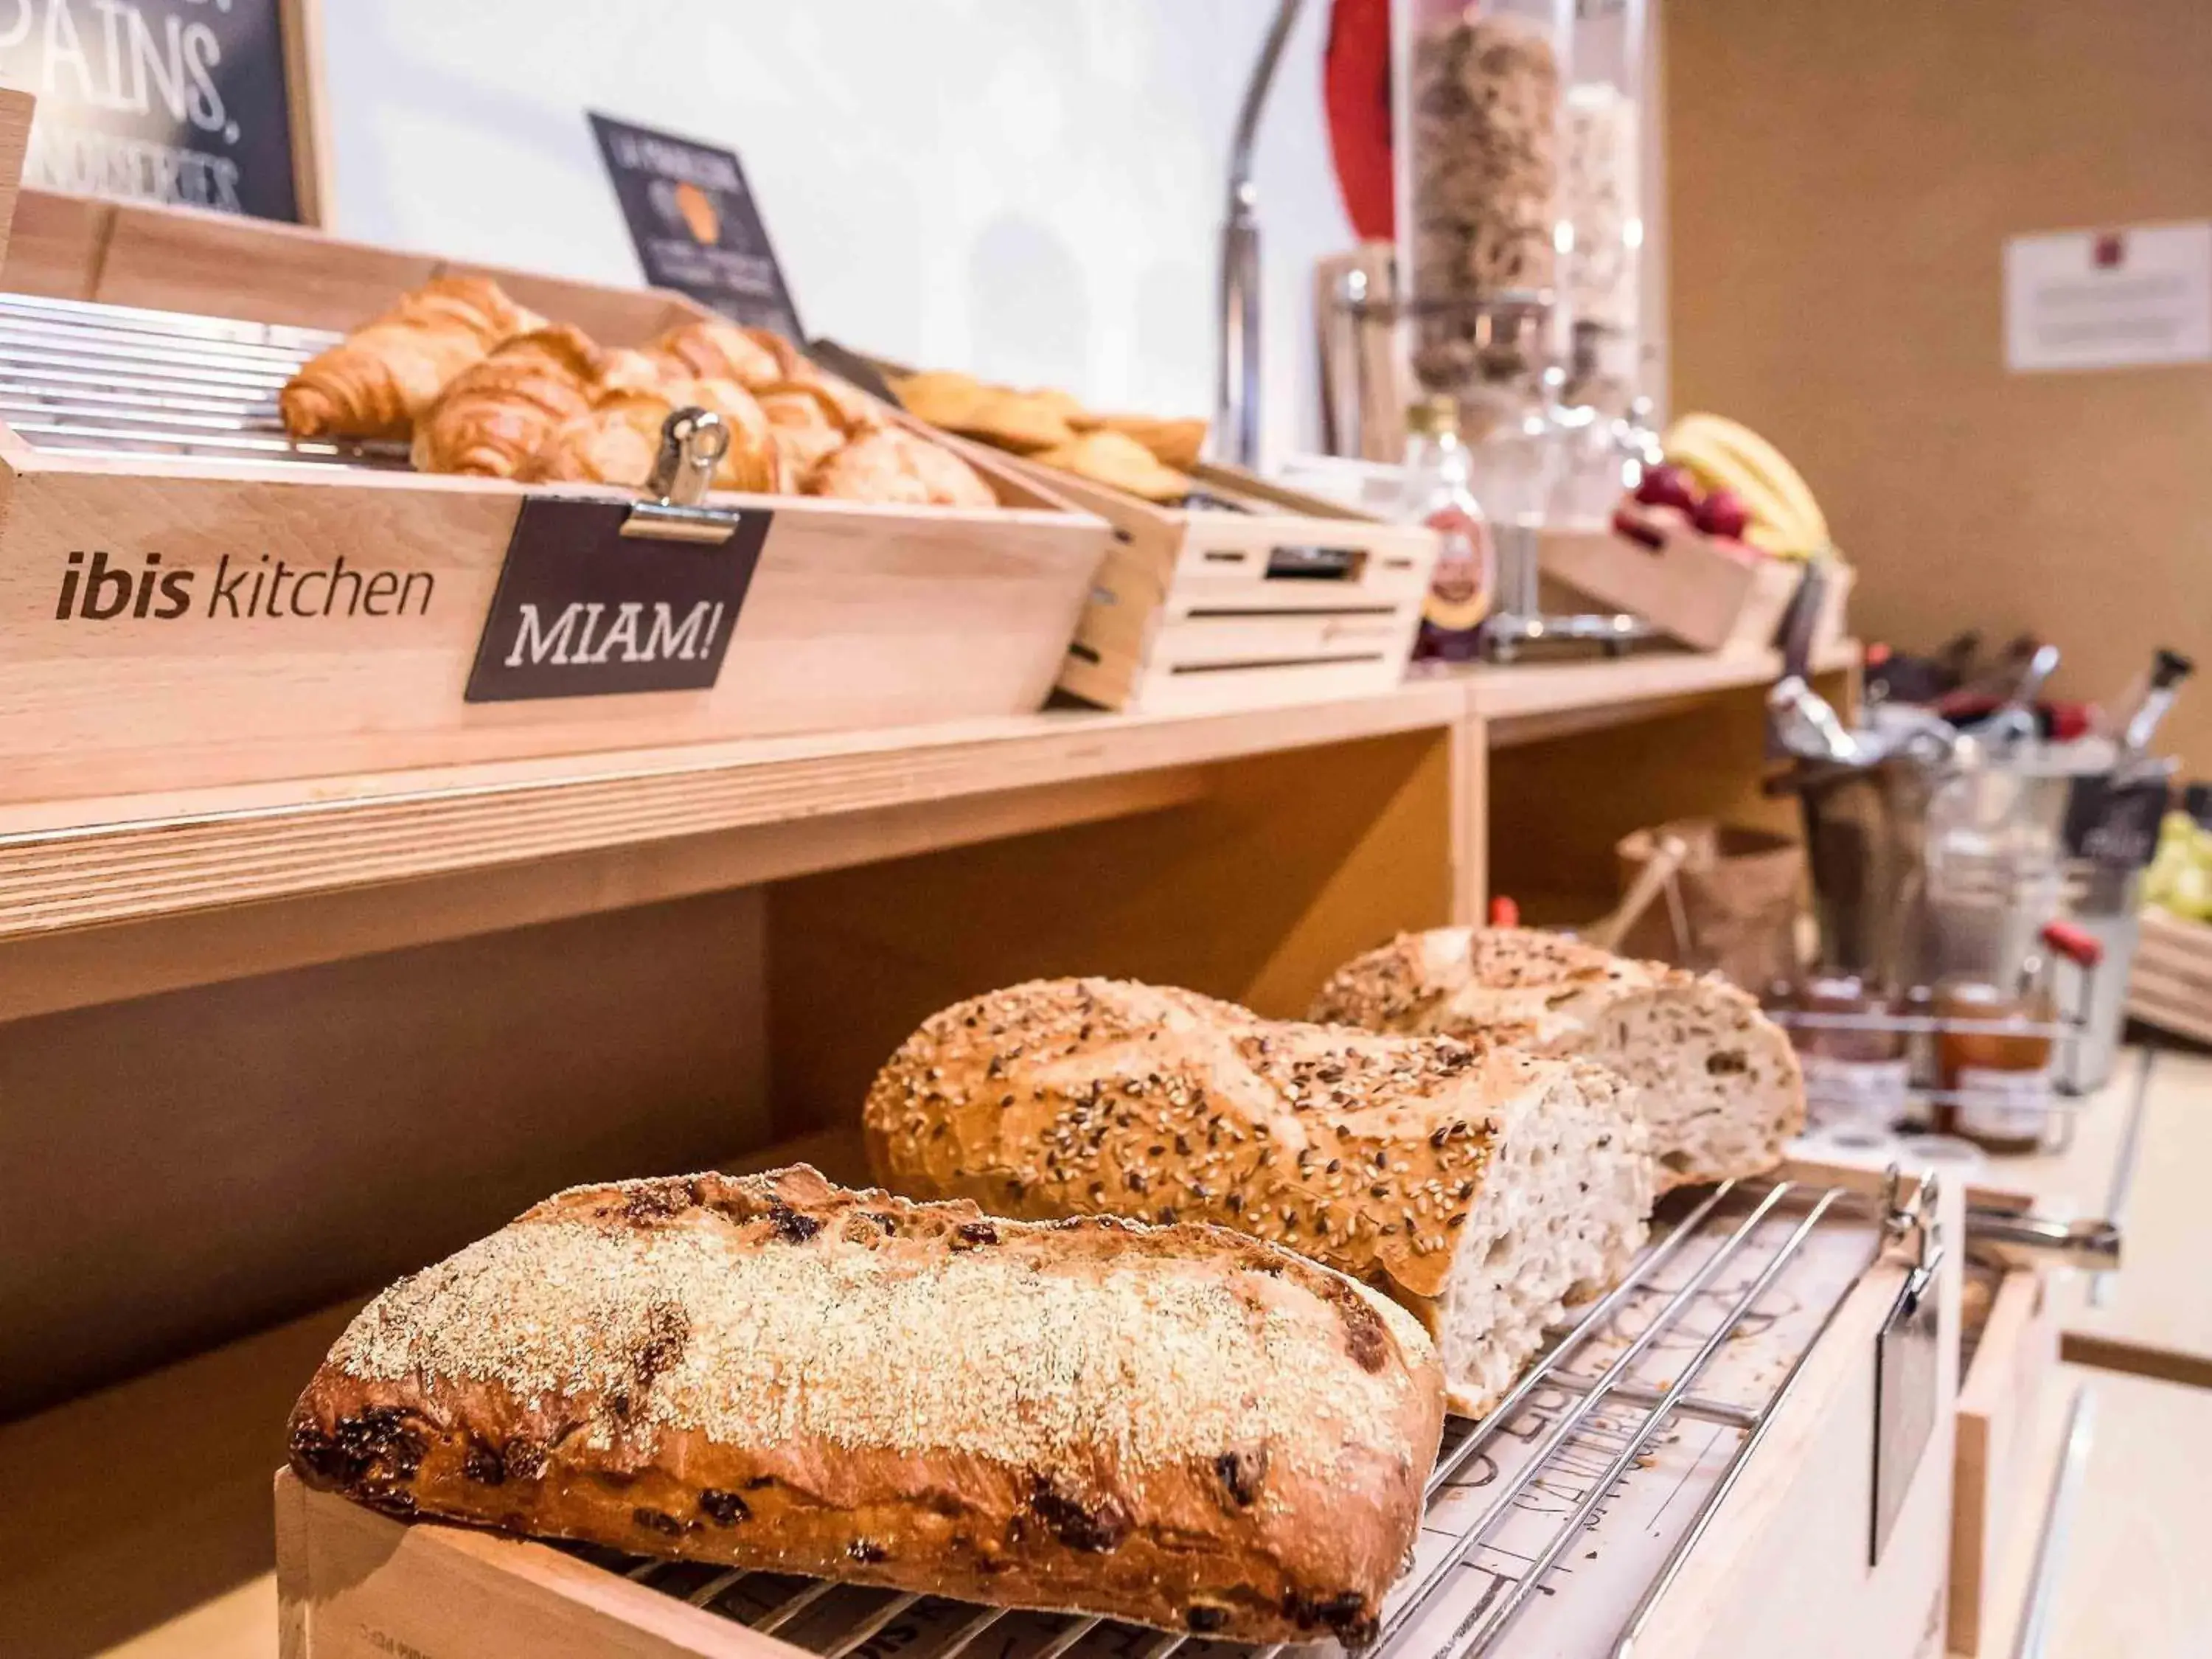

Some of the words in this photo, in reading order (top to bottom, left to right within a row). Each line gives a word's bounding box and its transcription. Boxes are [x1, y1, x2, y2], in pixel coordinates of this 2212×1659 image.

[55, 551, 195, 621] ibis
[207, 553, 434, 619] kitchen
[504, 601, 724, 667] MIAM!
